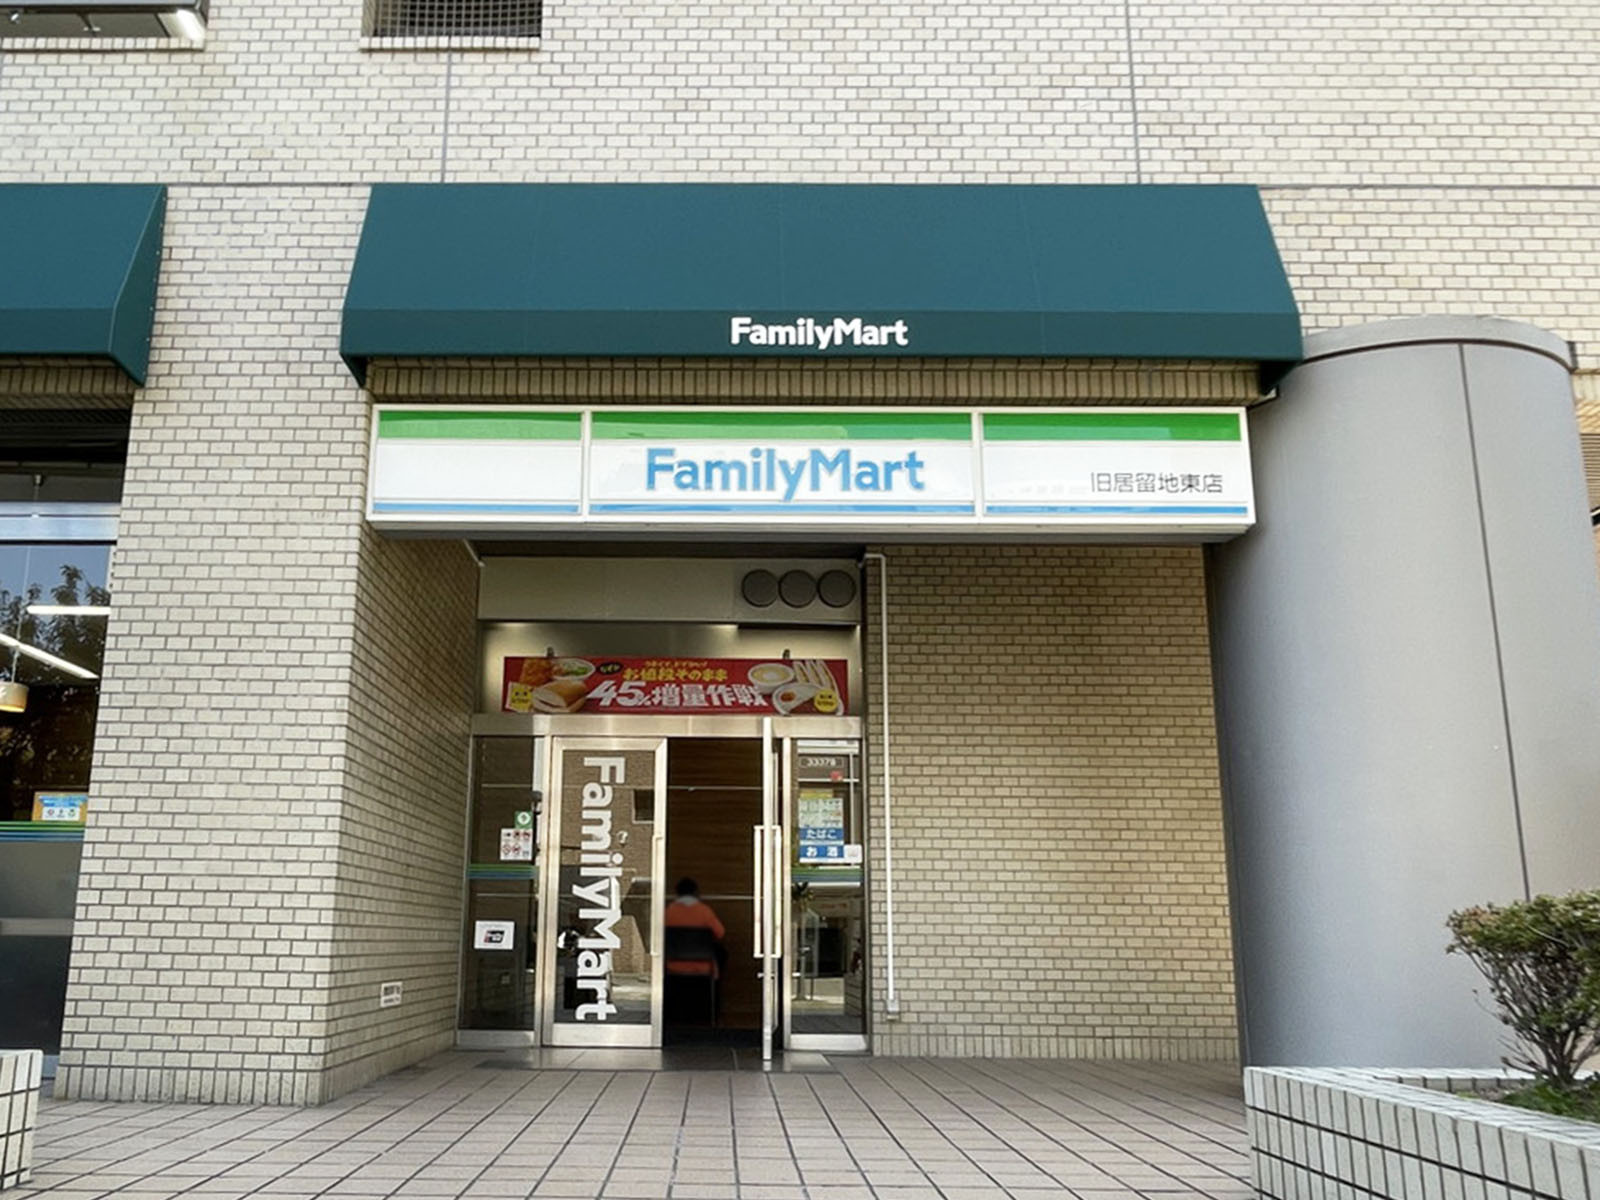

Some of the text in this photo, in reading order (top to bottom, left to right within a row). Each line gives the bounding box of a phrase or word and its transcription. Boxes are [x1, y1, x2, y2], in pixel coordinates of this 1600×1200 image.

[731, 317, 909, 350] FamilyMart
[645, 446, 925, 502] FamilyMart
[1091, 472, 1223, 495] 旧居留地東店
[622, 667, 728, 682] お値段そのまま
[806, 829, 838, 840] たばこ
[573, 756, 626, 1021] FamilyMart
